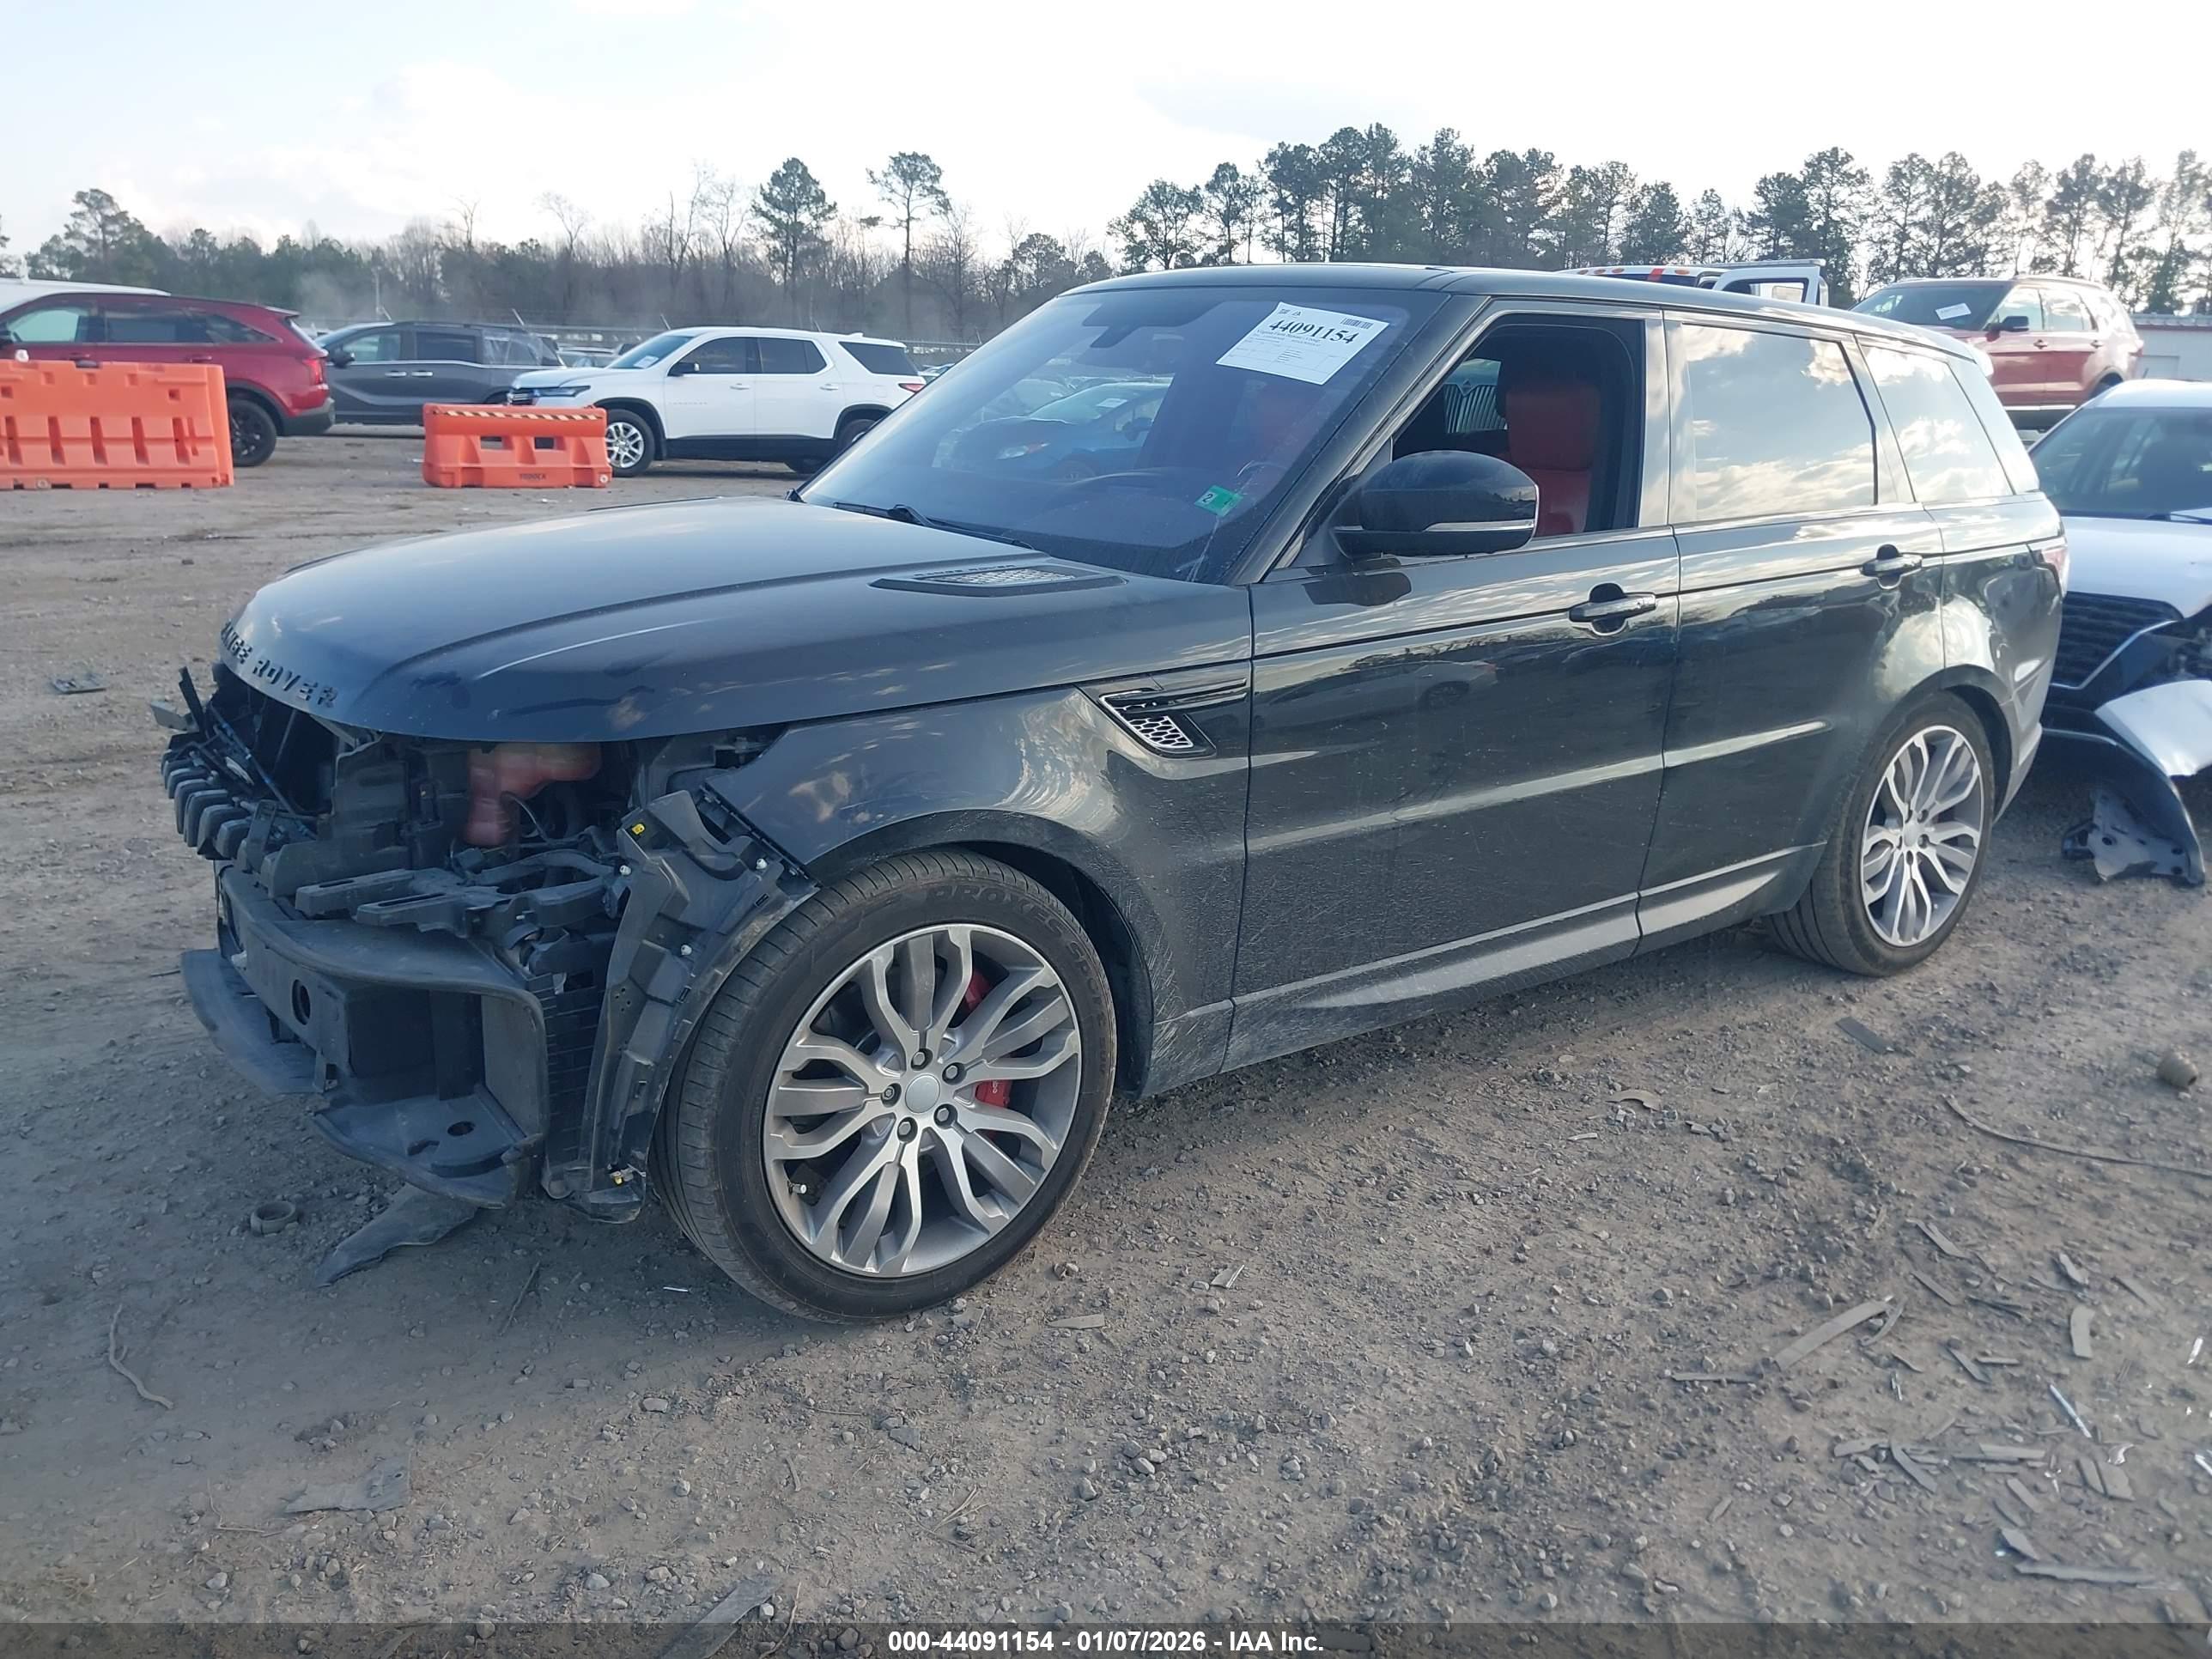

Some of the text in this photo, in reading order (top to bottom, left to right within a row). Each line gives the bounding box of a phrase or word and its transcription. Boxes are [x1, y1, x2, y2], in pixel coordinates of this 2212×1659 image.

[1269, 319, 1359, 343] 44091154
[1202, 493, 1213, 502] 2
[252, 659, 338, 708] ROVER
